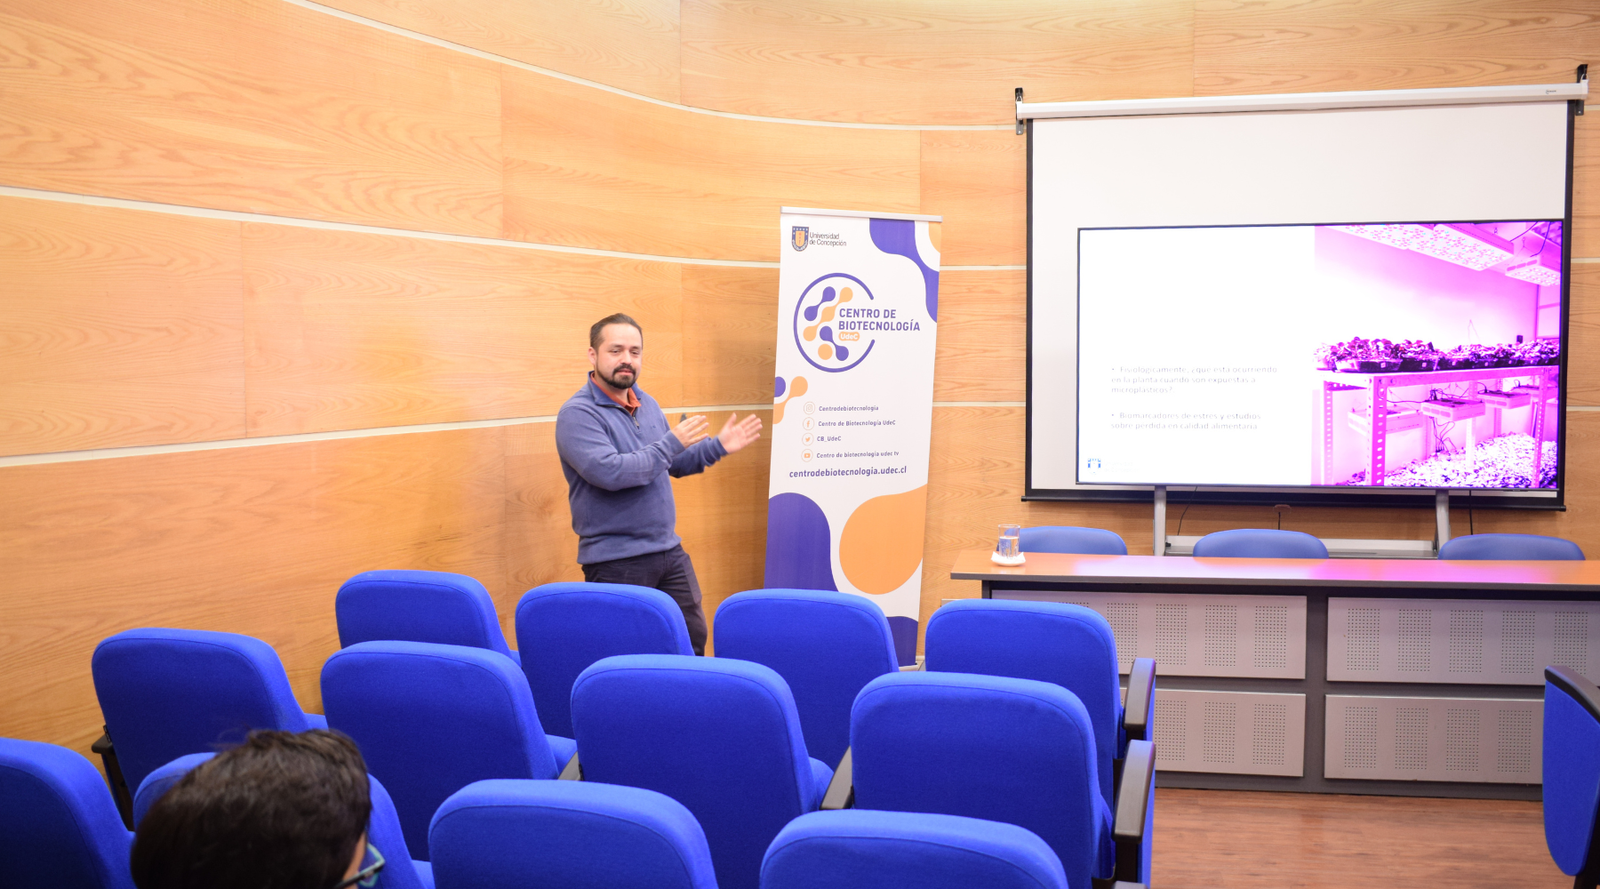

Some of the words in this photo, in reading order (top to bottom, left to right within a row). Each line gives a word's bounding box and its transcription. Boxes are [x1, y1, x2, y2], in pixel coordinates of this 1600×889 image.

[809, 232, 840, 240] Universidad
[816, 239, 847, 247] Concepción
[839, 308, 881, 318] CENTRO
[883, 309, 897, 319] DE
[838, 319, 921, 331] BIOTECNOLOGÍA
[1132, 376, 1158, 384] planta
[1207, 376, 1249, 384] expuestas
[1119, 412, 1180, 420] Biomarcadores
[1219, 413, 1225, 421] y
[1226, 412, 1262, 420] estudios
[1180, 422, 1209, 430] calidad
[1211, 422, 1258, 430] alimentaria
[789, 465, 907, 478] centrodebiotecnologia.udec.cl
